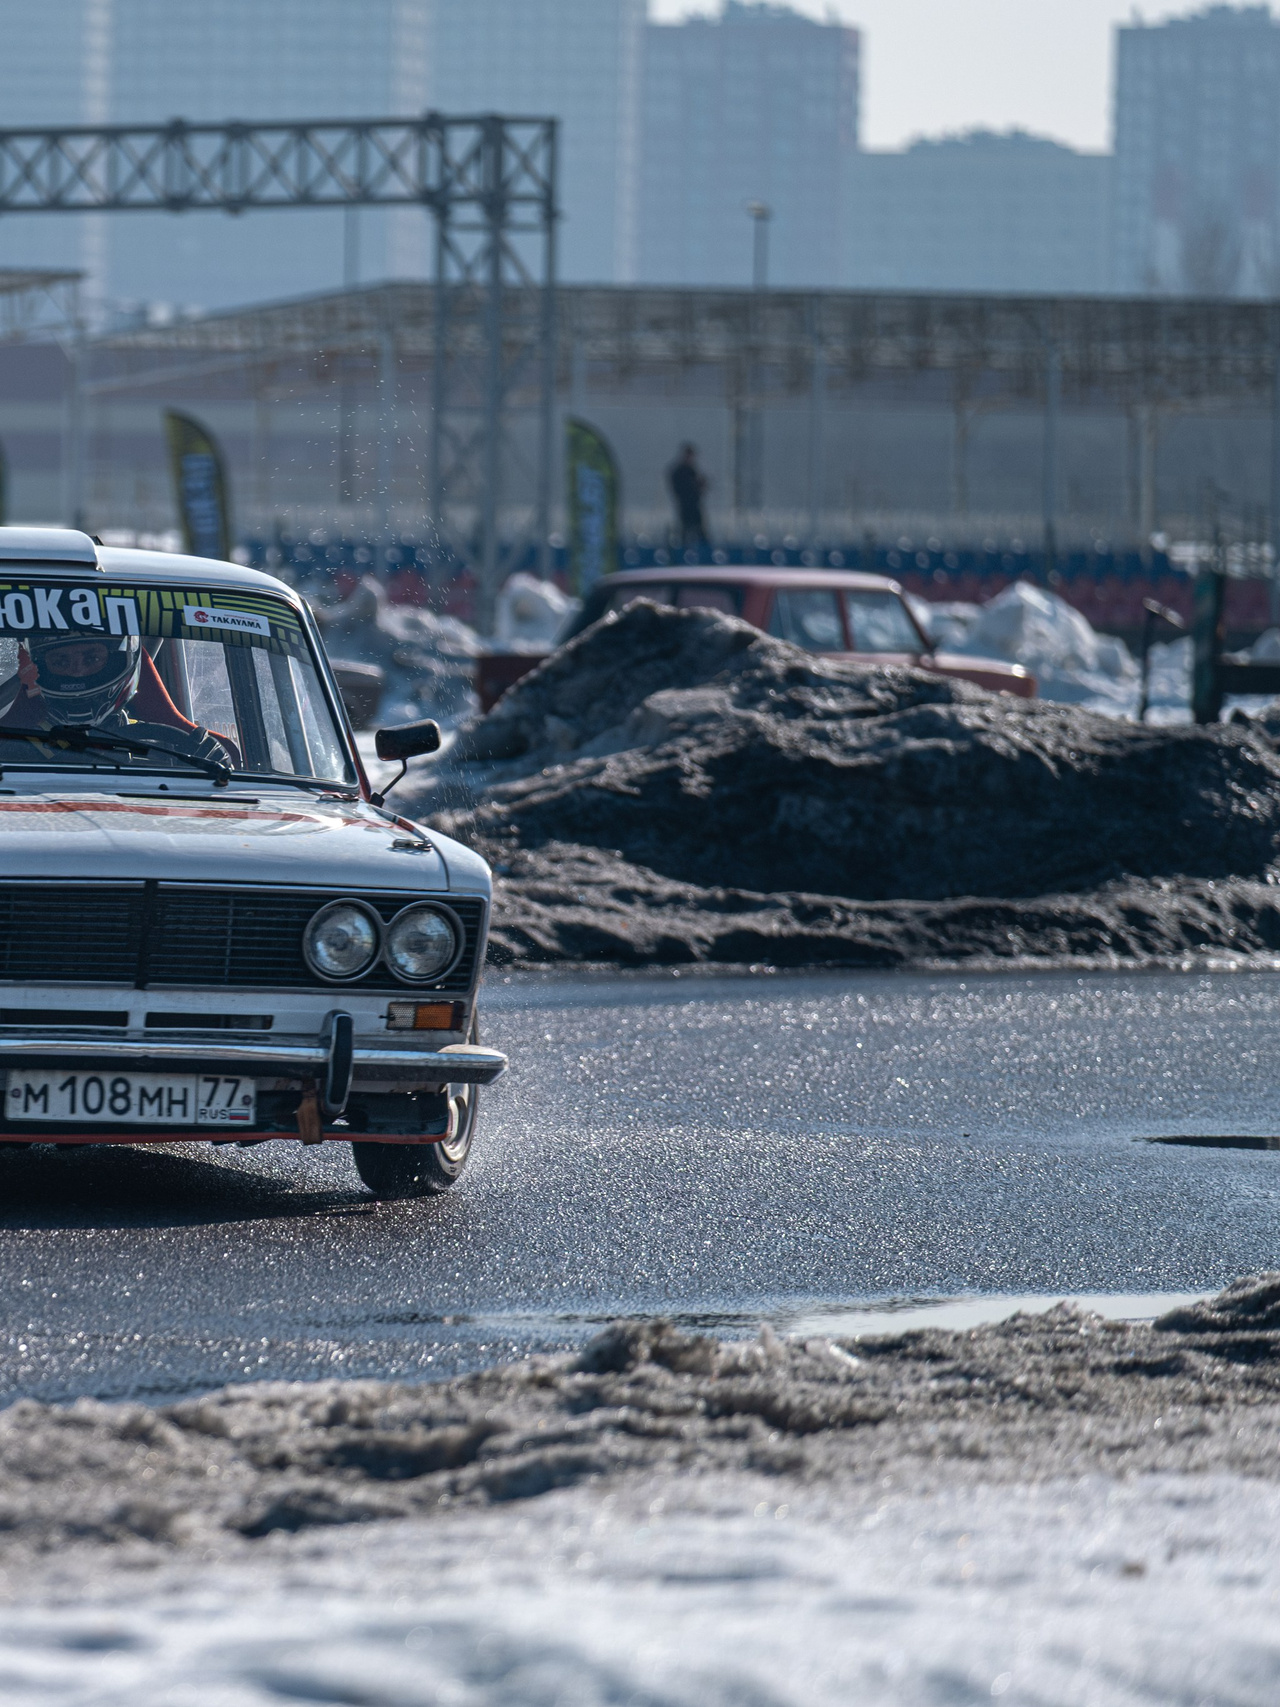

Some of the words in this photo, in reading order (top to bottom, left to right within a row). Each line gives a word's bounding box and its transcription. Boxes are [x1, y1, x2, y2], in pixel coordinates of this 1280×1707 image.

[210, 615, 262, 630] TAKAYAMA
[202, 1077, 241, 1107] 77
[199, 1108, 228, 1121] RUS
